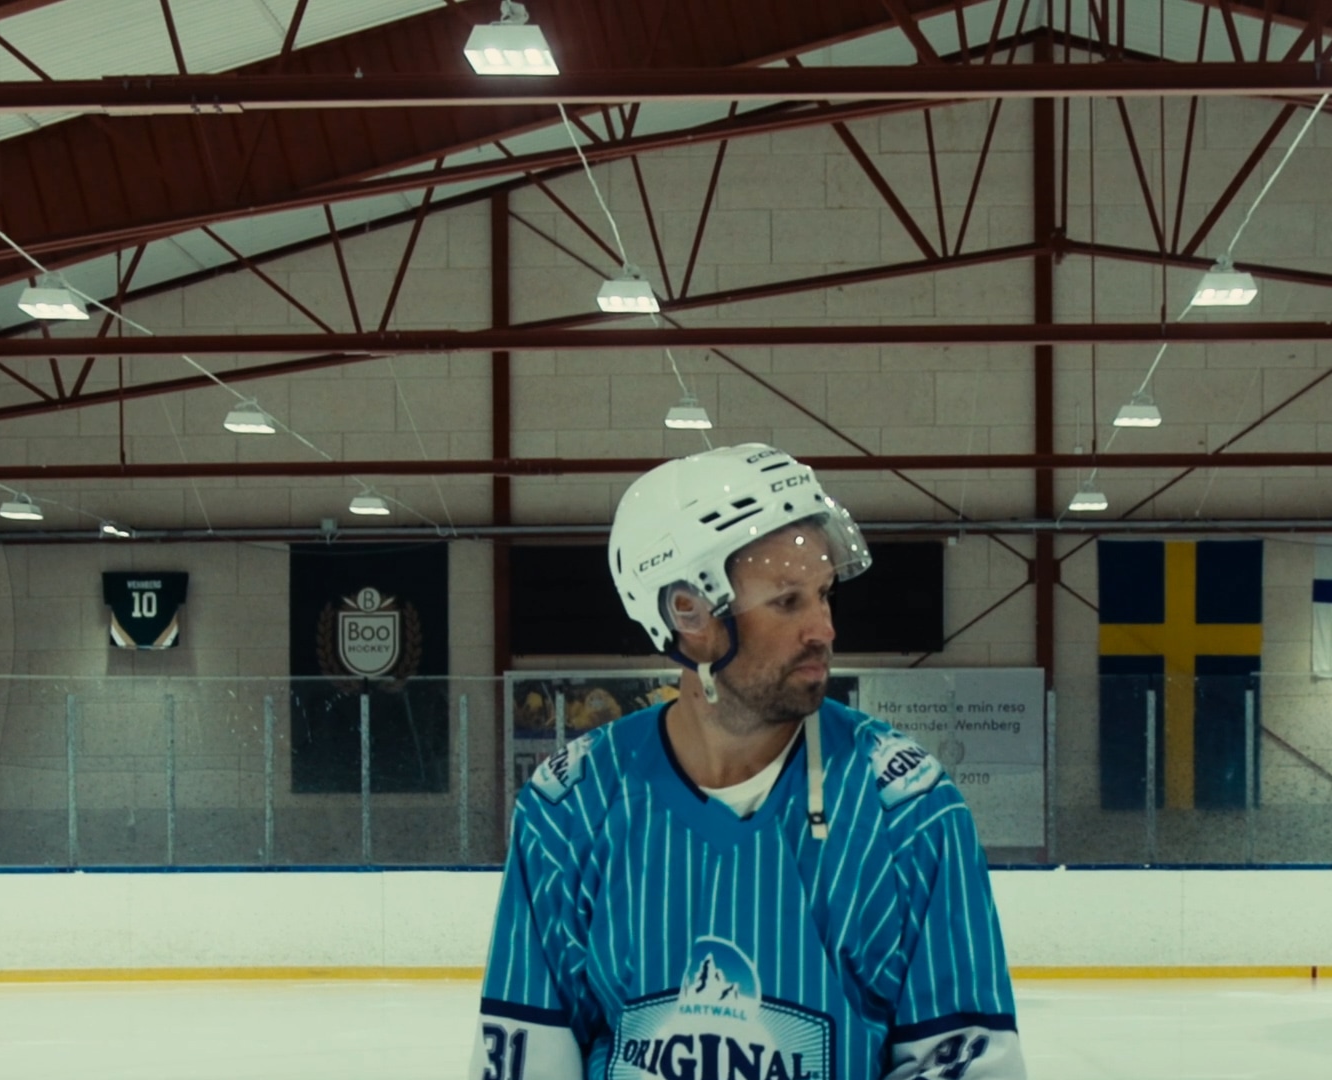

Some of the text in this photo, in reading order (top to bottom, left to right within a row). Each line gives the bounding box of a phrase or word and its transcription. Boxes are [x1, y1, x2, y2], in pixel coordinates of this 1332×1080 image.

[771, 474, 811, 493] CCM
[638, 549, 674, 573] CCM
[131, 591, 157, 618] 10
[363, 590, 375, 610] B
[348, 621, 390, 642] Boo
[348, 645, 391, 653] HOCKEY
[878, 701, 903, 713] Här
[906, 702, 964, 713] startae
[968, 701, 994, 713] min
[887, 720, 948, 732] lexander
[959, 773, 990, 785] 2010
